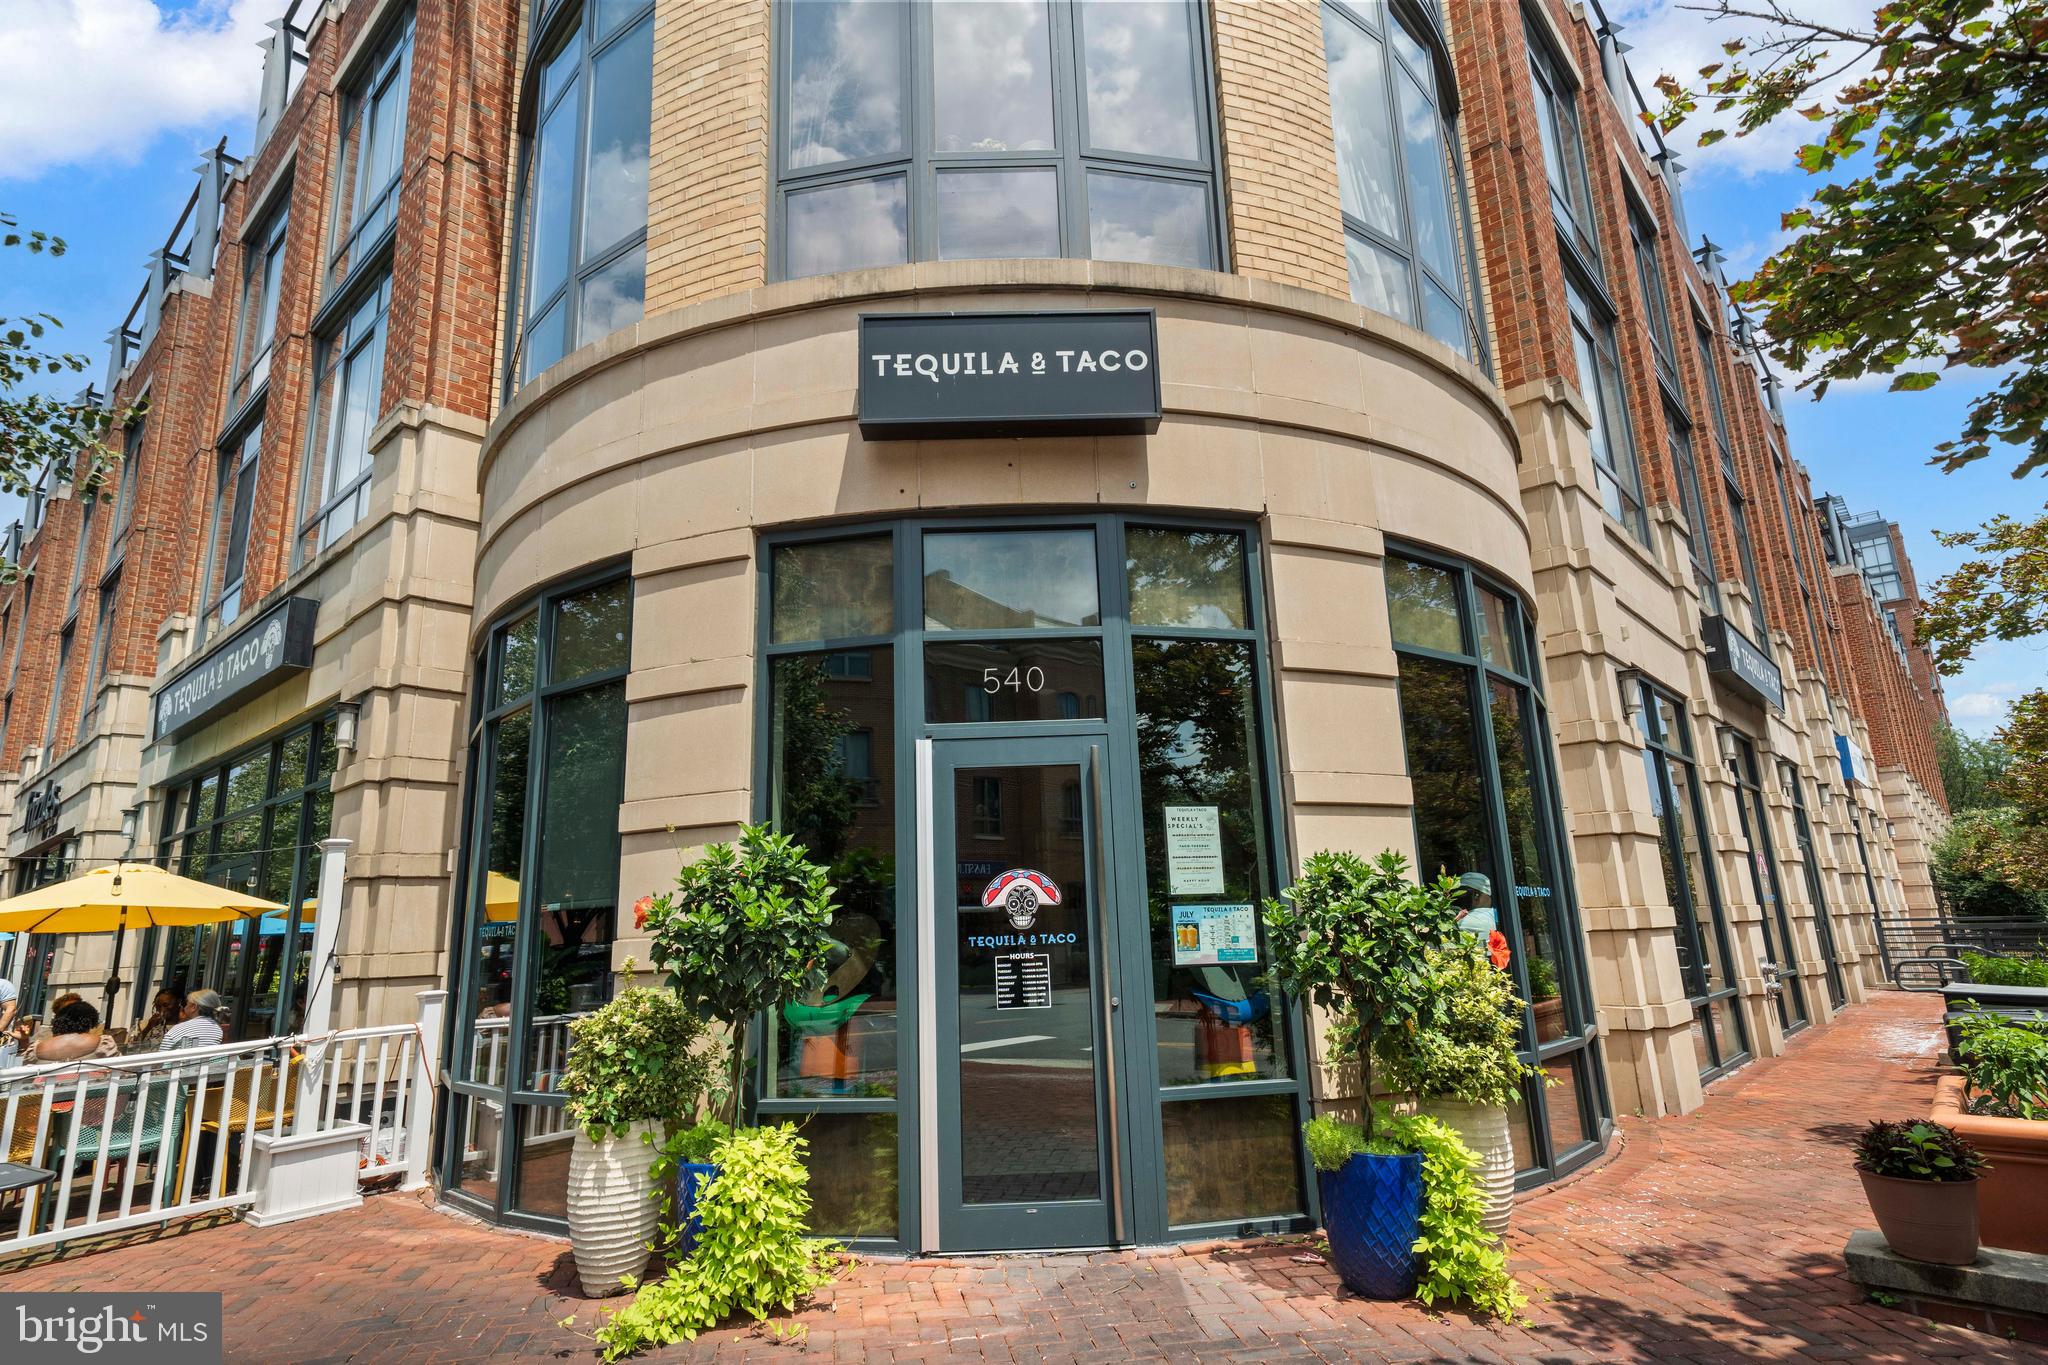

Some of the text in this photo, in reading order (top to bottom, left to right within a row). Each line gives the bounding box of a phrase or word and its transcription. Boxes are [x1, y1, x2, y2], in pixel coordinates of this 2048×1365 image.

[871, 349, 1149, 383] TEQUILA & TACO
[1741, 647, 1765, 681] TEQUILA
[173, 637, 260, 715] TEQUILA & TACO
[983, 666, 1045, 694] 540
[1515, 886, 1534, 899] EQUILA
[1537, 886, 1550, 897] TACO
[1179, 910, 1194, 919] JULY
[480, 926, 500, 940] TEQUILA
[505, 925, 516, 936] TAC
[968, 933, 1077, 949] TEQUILA & TACO
[1009, 952, 1035, 960] HOURS
